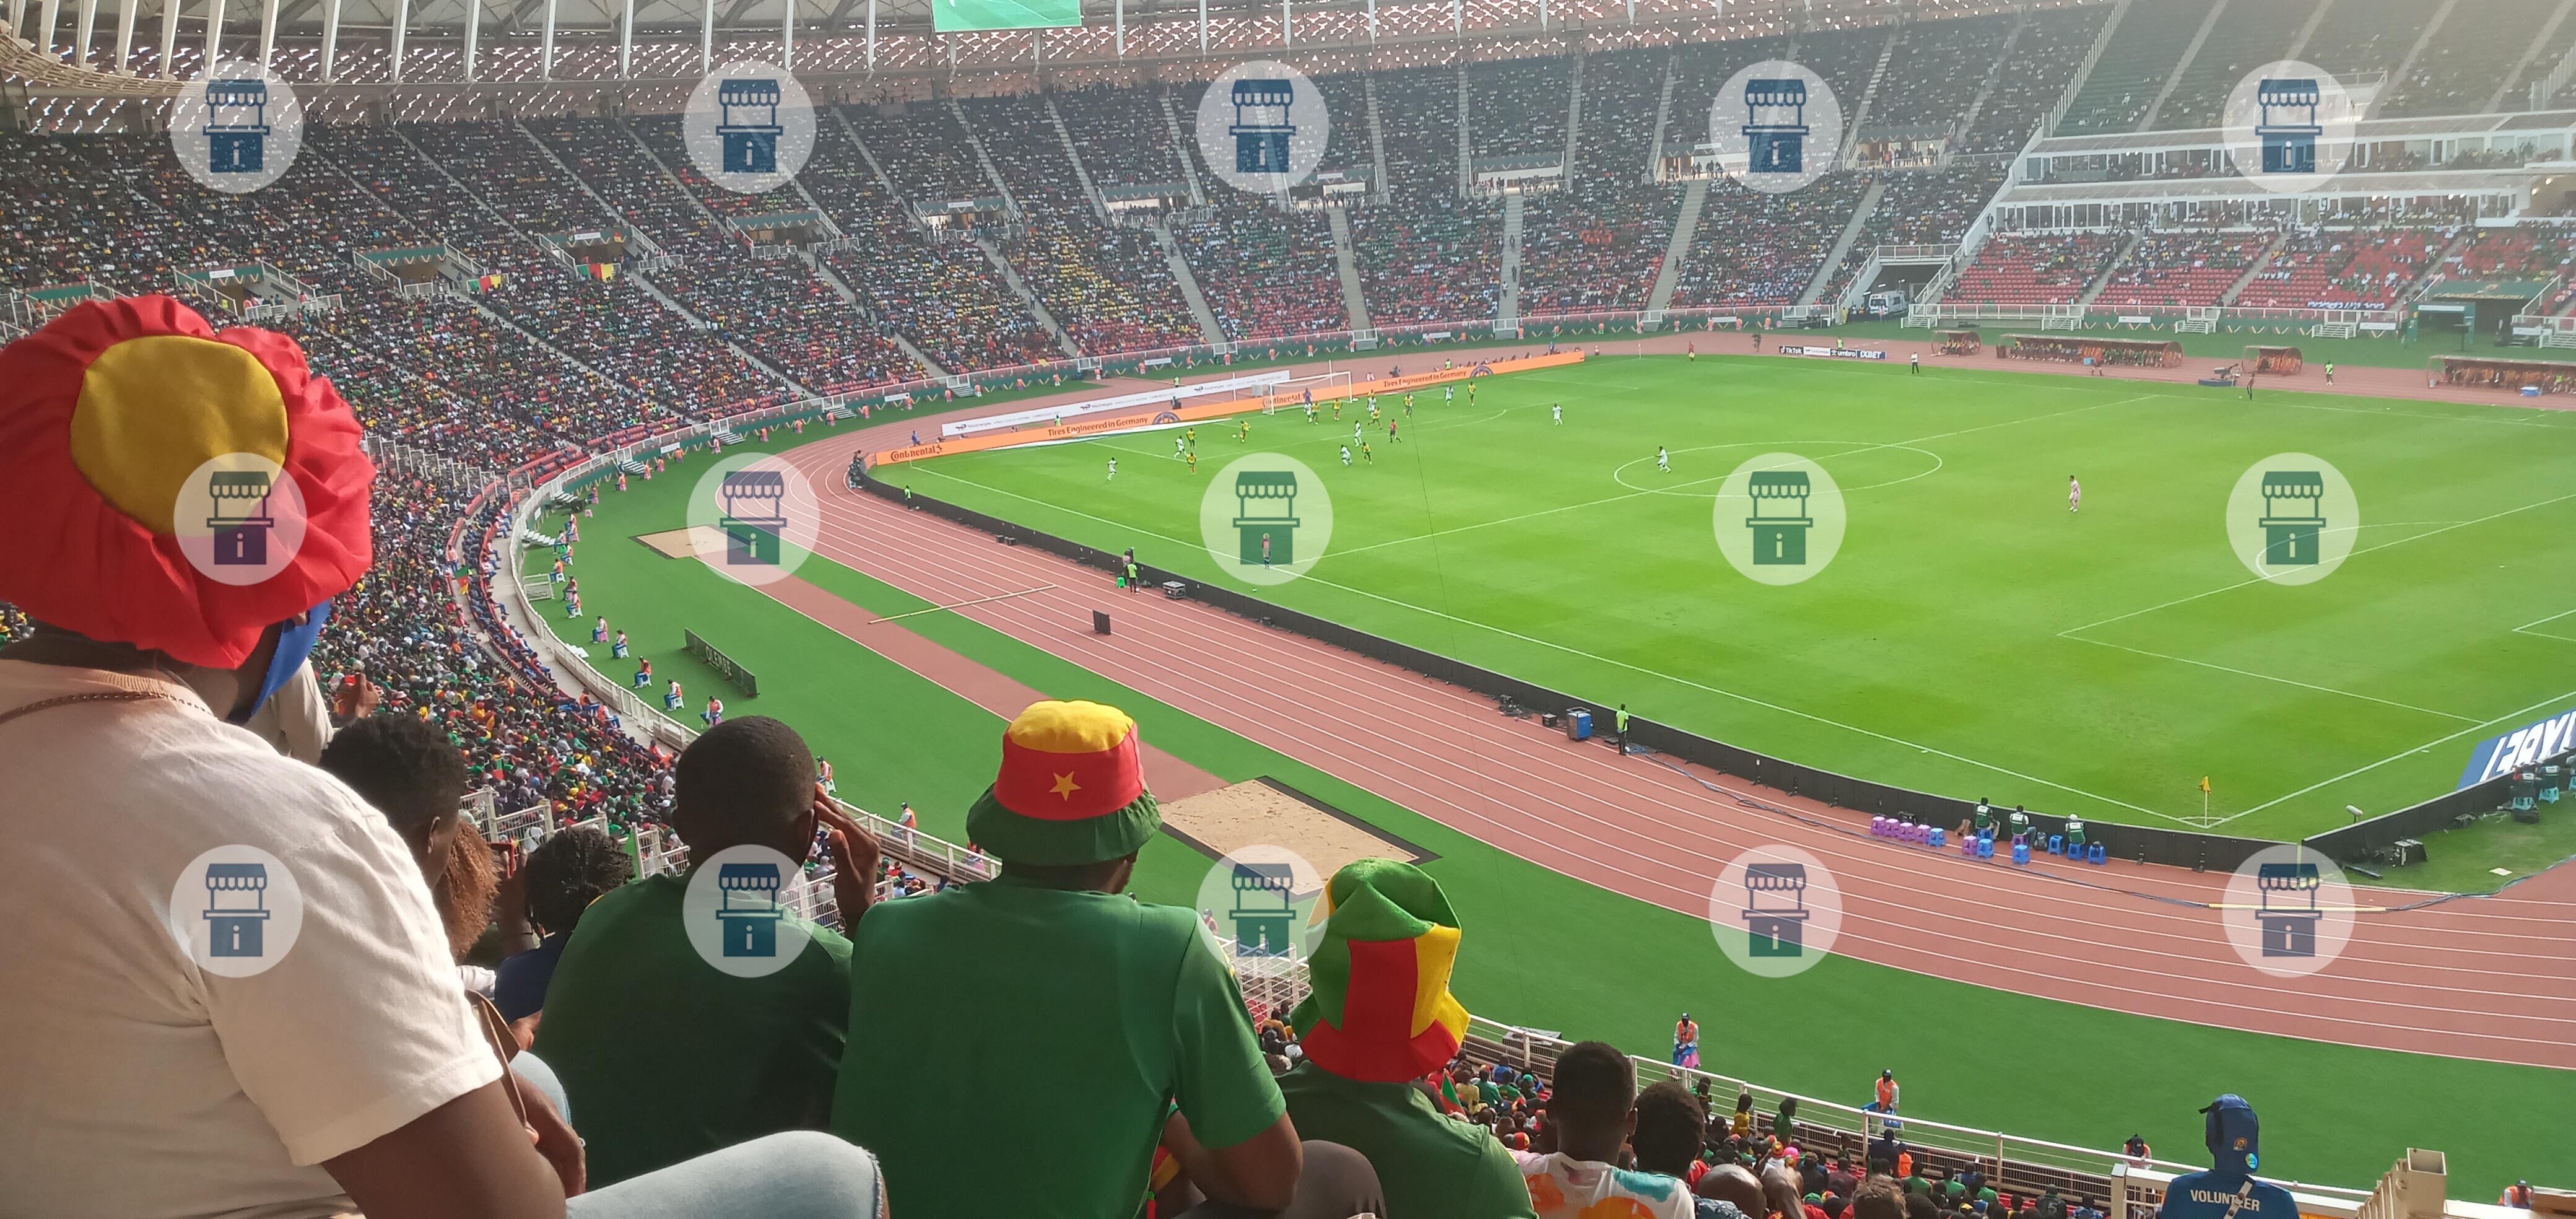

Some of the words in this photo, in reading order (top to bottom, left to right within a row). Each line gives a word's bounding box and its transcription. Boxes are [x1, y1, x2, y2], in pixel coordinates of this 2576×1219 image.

[1860, 351, 1881, 359] 1XBET
[1399, 374, 1432, 385] Engineered
[1440, 370, 1466, 379] Germany
[1048, 428, 1065, 436] Tires
[1066, 421, 1107, 434] Engineered
[1116, 417, 1148, 427] Germany
